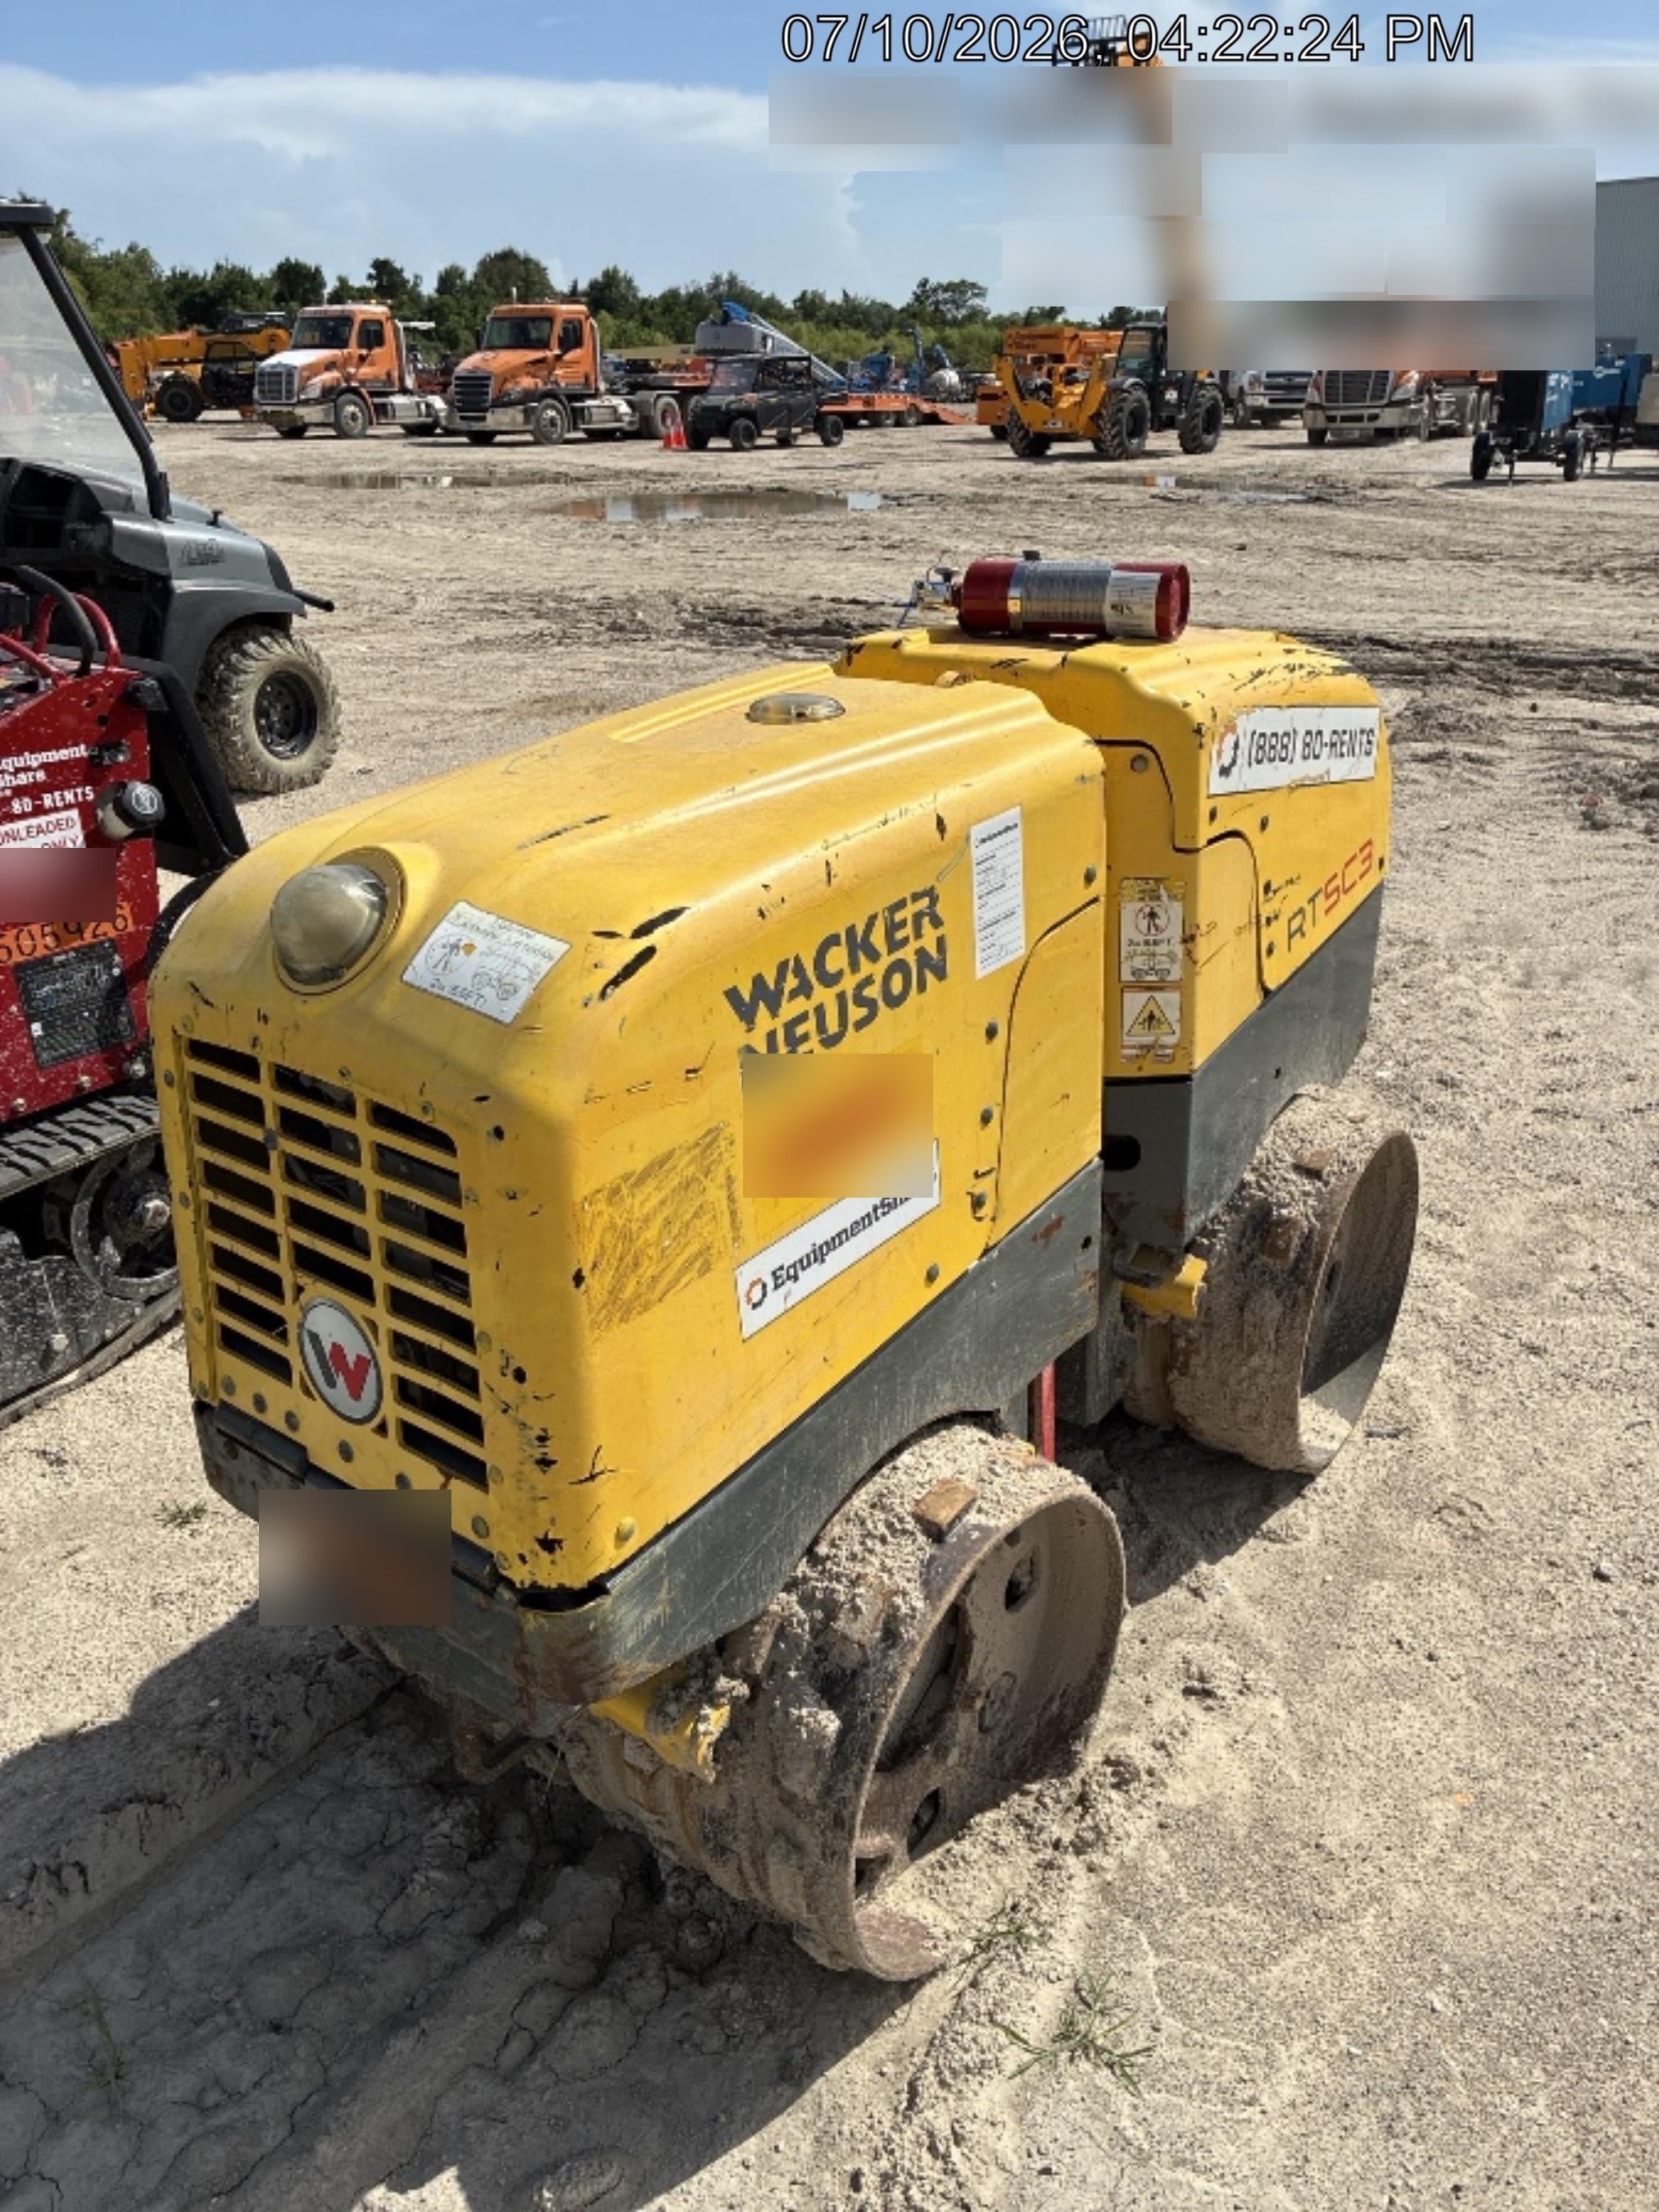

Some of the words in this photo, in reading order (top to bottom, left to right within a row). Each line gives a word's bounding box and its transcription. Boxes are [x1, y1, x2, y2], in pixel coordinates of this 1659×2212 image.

[0, 743, 88, 773] quipment
[1248, 728, 1298, 768] (888)
[1302, 727, 1375, 760] 80-RENTS
[723, 885, 945, 1032] WACKER
